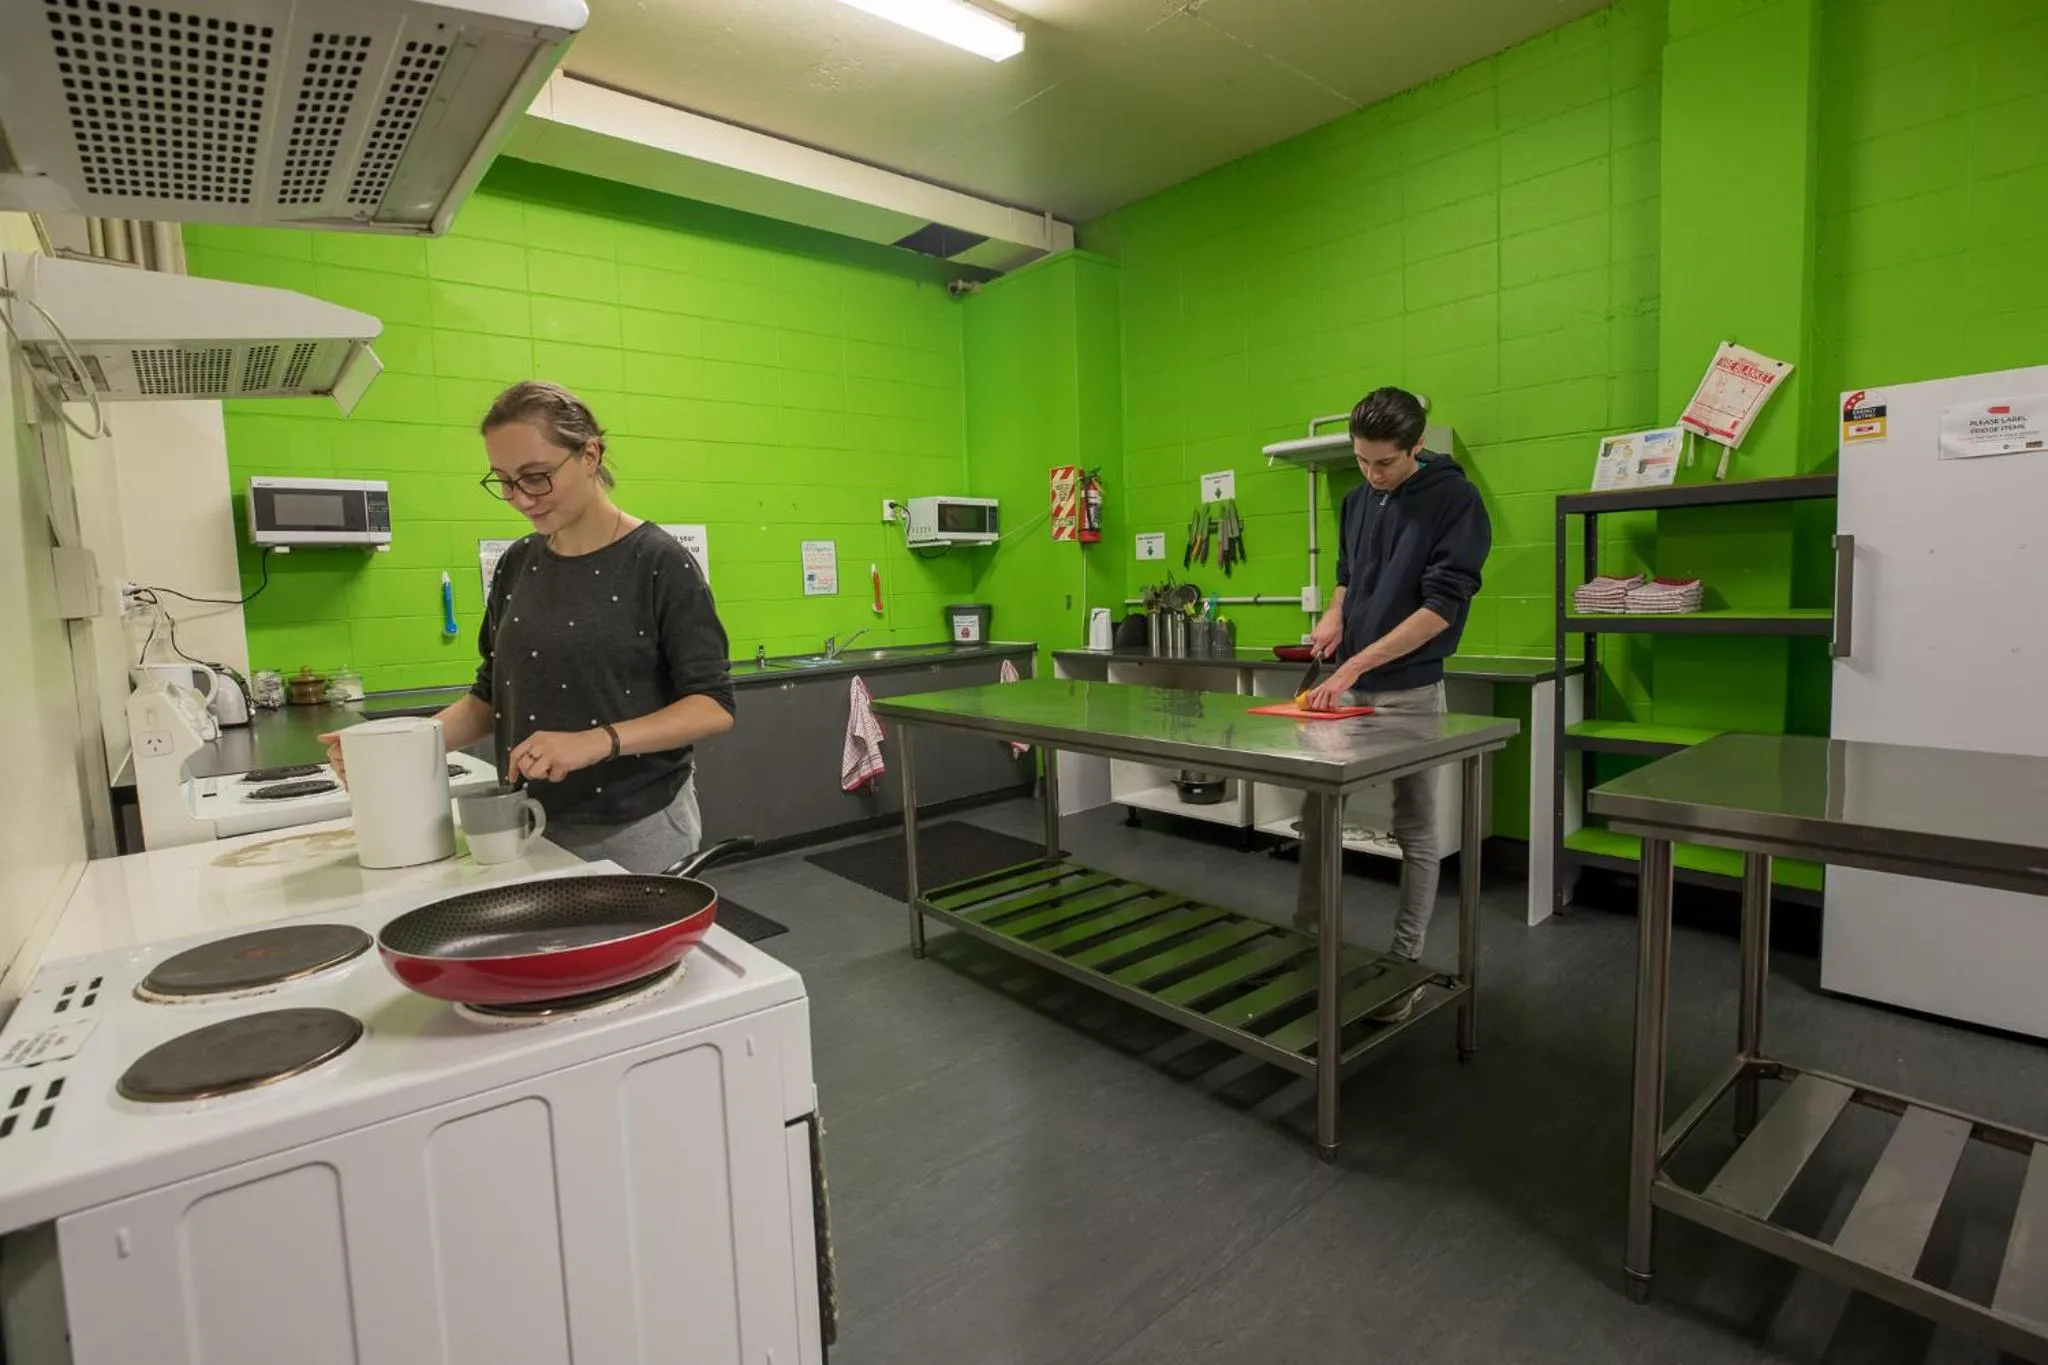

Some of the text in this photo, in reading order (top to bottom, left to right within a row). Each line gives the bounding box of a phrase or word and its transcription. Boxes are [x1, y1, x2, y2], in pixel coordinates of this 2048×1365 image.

[1853, 407, 1876, 415] ENERGY
[1969, 416, 2027, 426] PLEASE LABEL
[1970, 424, 2025, 434] FRIDGE ITEMS
[680, 535, 695, 543] your
